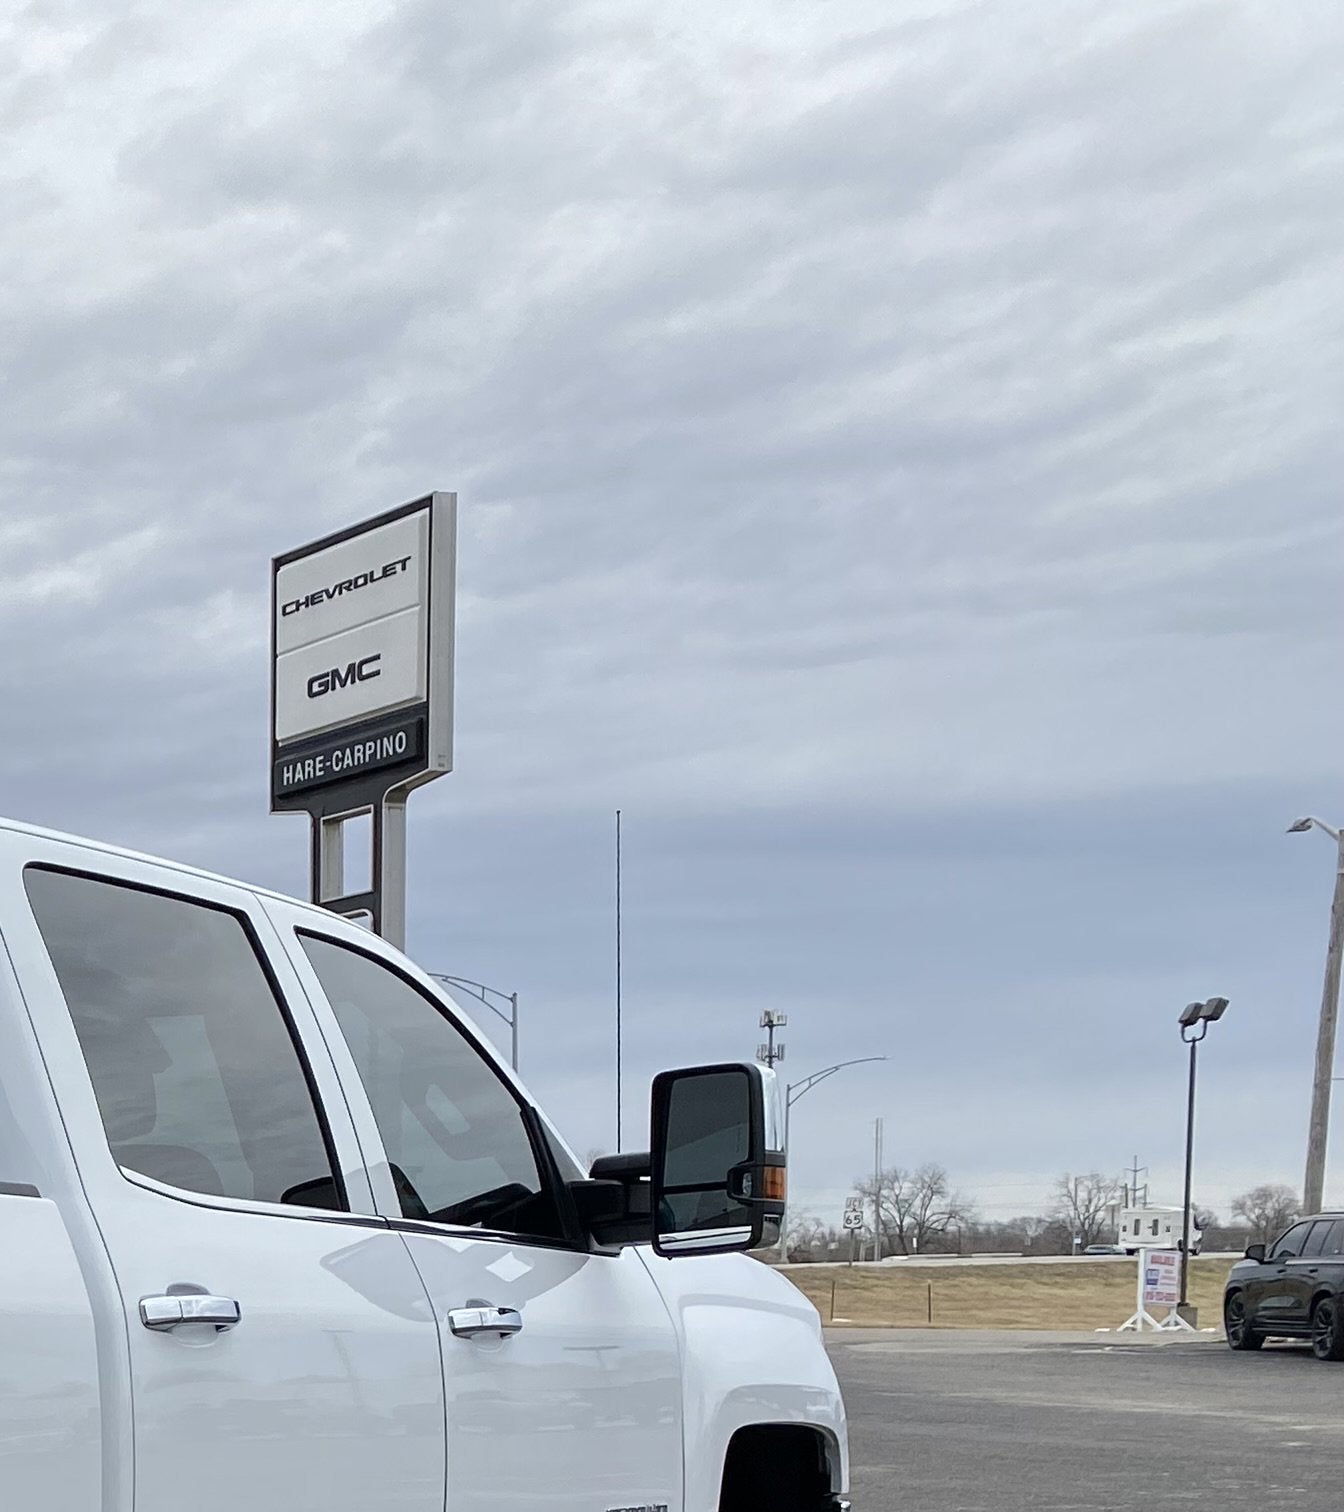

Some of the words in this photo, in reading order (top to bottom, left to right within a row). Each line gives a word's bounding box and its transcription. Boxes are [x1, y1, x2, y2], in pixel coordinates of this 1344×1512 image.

[281, 556, 411, 617] CHEVROLET
[307, 653, 382, 699] GMC
[283, 730, 408, 787] HARE-CARPINO
[846, 1215, 861, 1225] 65
